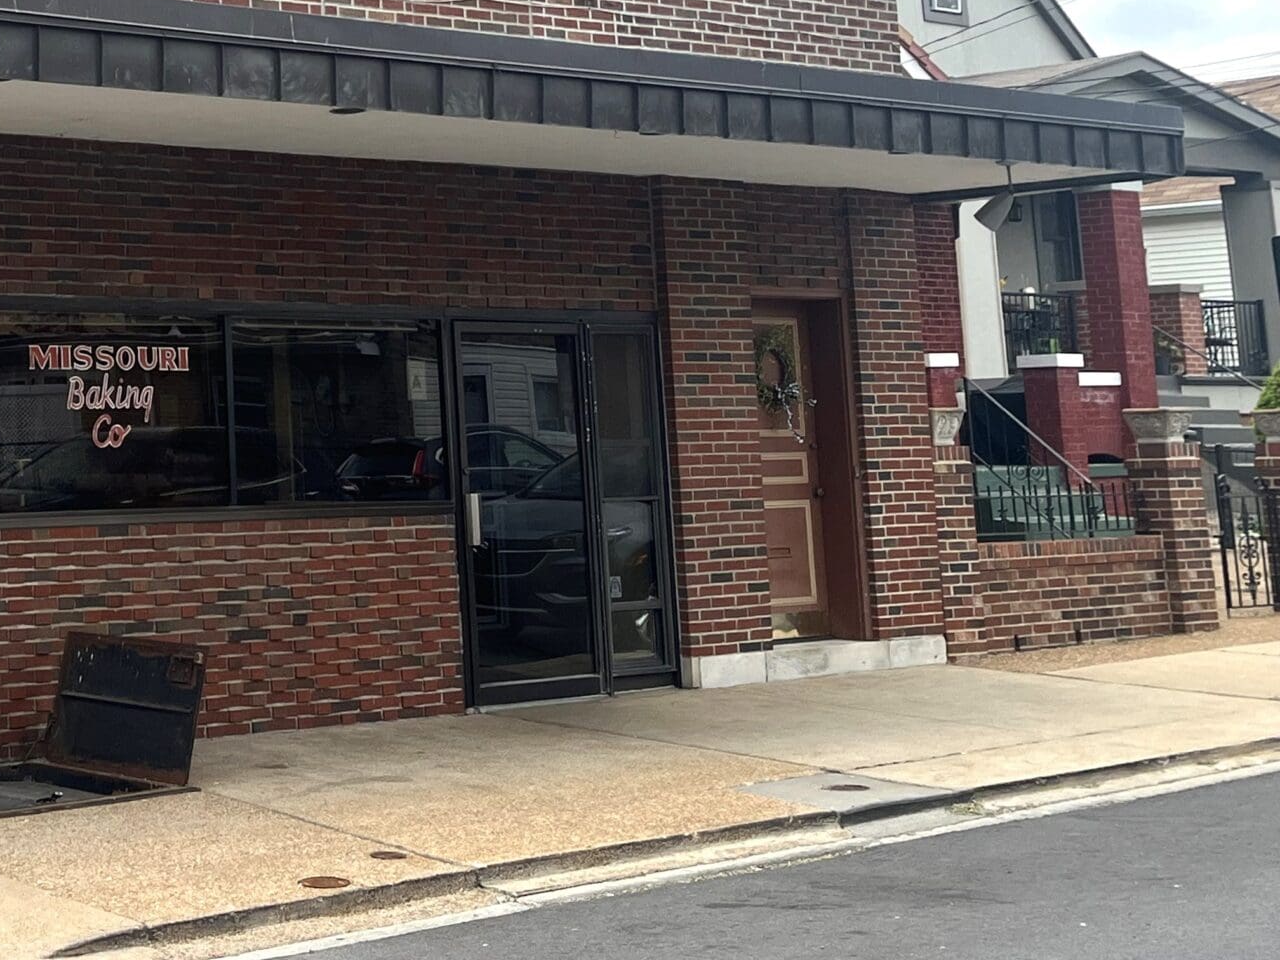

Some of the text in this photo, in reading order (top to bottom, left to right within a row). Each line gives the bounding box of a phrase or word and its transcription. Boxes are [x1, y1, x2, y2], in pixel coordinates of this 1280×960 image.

[28, 344, 190, 372] MISSOURI
[67, 372, 155, 423] Baking
[92, 413, 132, 449] Co
